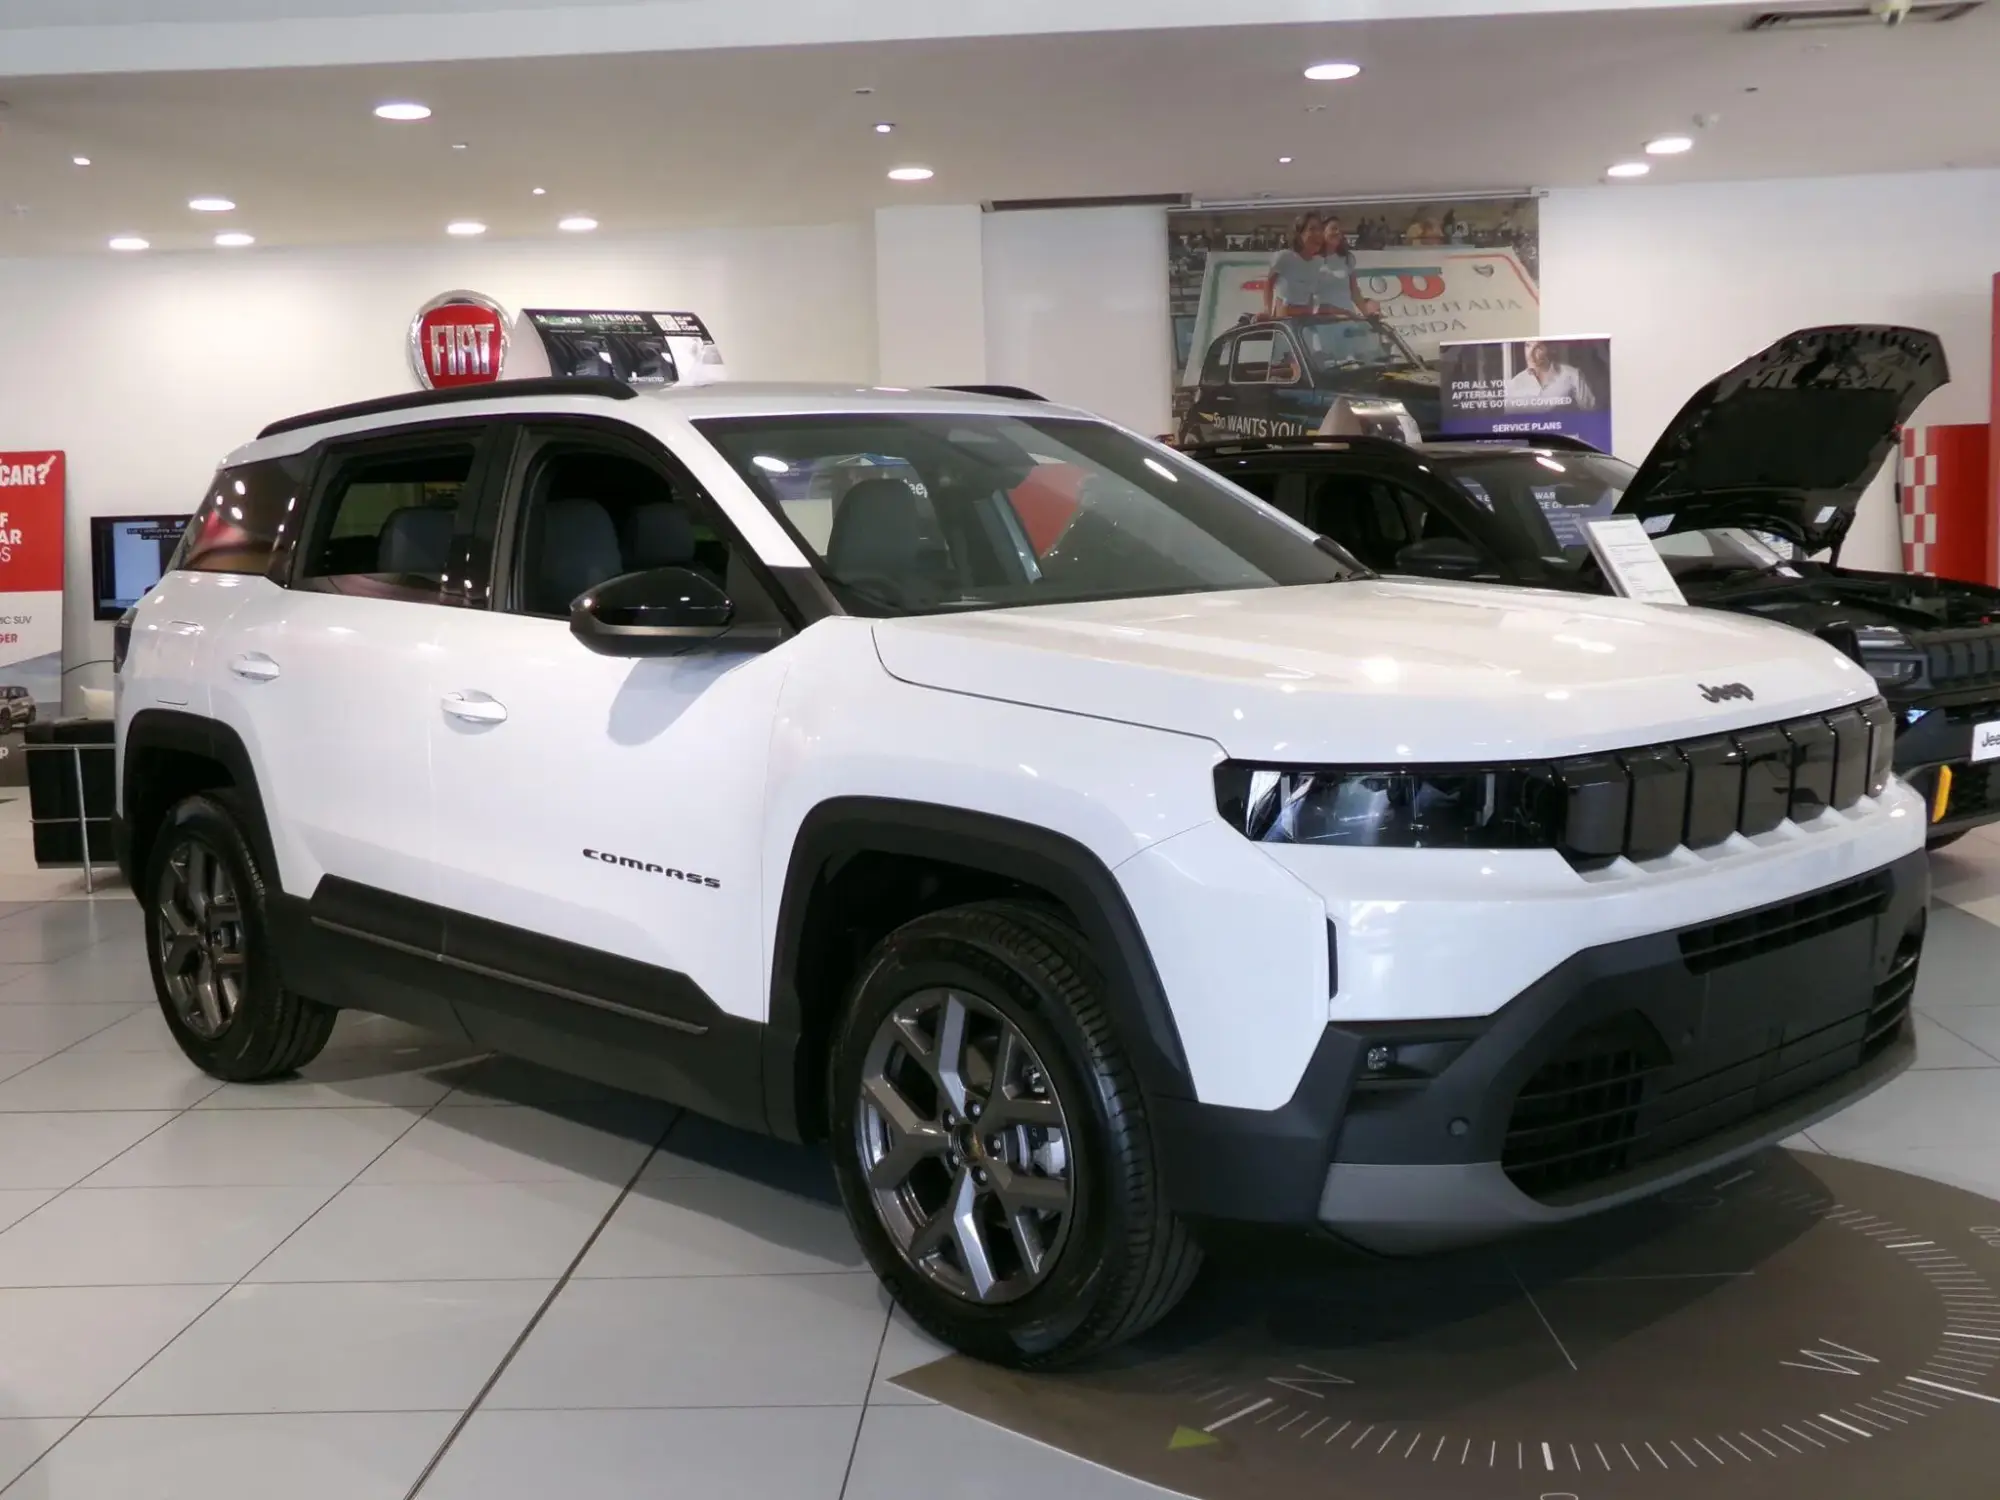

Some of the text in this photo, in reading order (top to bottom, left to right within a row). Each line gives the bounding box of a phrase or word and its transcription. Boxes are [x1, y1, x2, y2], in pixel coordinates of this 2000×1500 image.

[589, 314, 644, 322] INTERIOR
[430, 323, 495, 376] FIAT
[1452, 381, 1470, 390] FOR
[1472, 380, 1489, 389] ALL
[1490, 399, 1507, 408] GOT
[1530, 396, 1573, 406] COVERED
[1227, 415, 1268, 438] WANTS
[1270, 420, 1303, 437] YOU
[1492, 421, 1562, 433] SERVICE PLANS
[13, 615, 33, 625] SUV
[1698, 682, 1754, 703] Jeep
[1981, 731, 2000, 748] Jee
[582, 848, 721, 889] COMPASS
